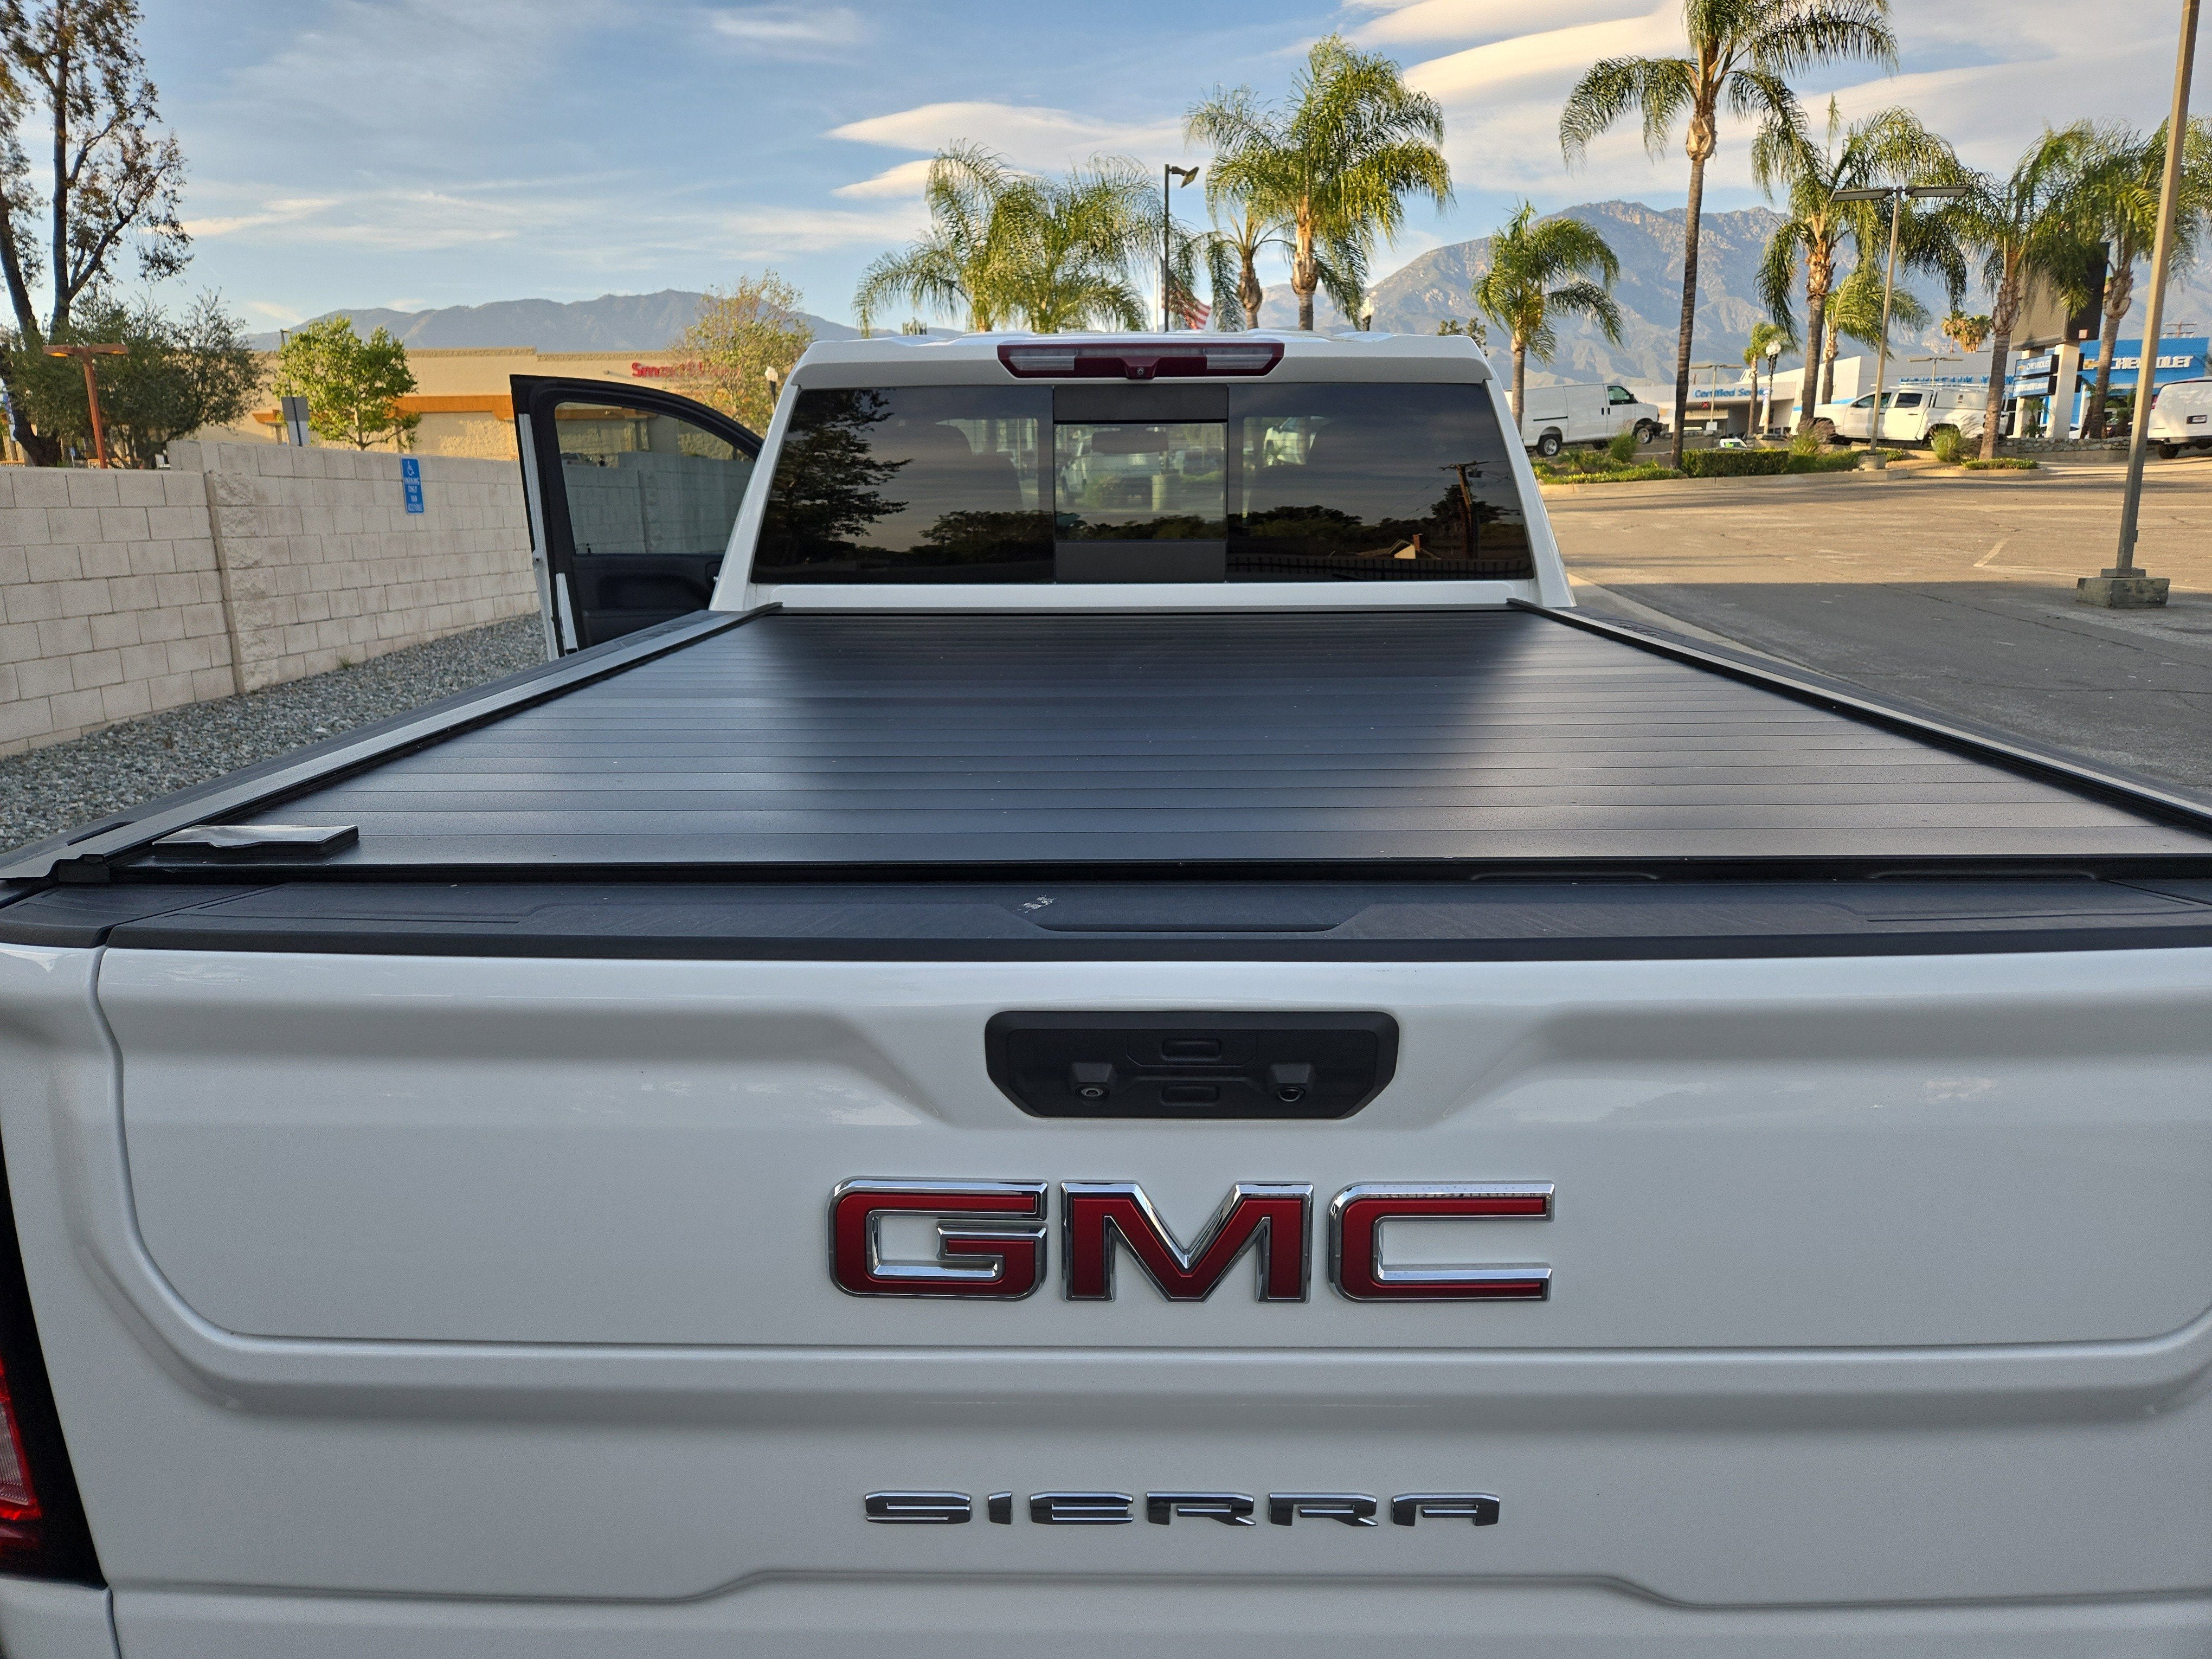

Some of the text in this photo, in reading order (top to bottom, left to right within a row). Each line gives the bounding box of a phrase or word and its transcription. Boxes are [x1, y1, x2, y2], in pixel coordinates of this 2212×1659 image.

[2111, 356, 2194, 370] HEOLET
[828, 1175, 1555, 1303] GMC
[865, 1490, 1501, 1527] SIERRA
